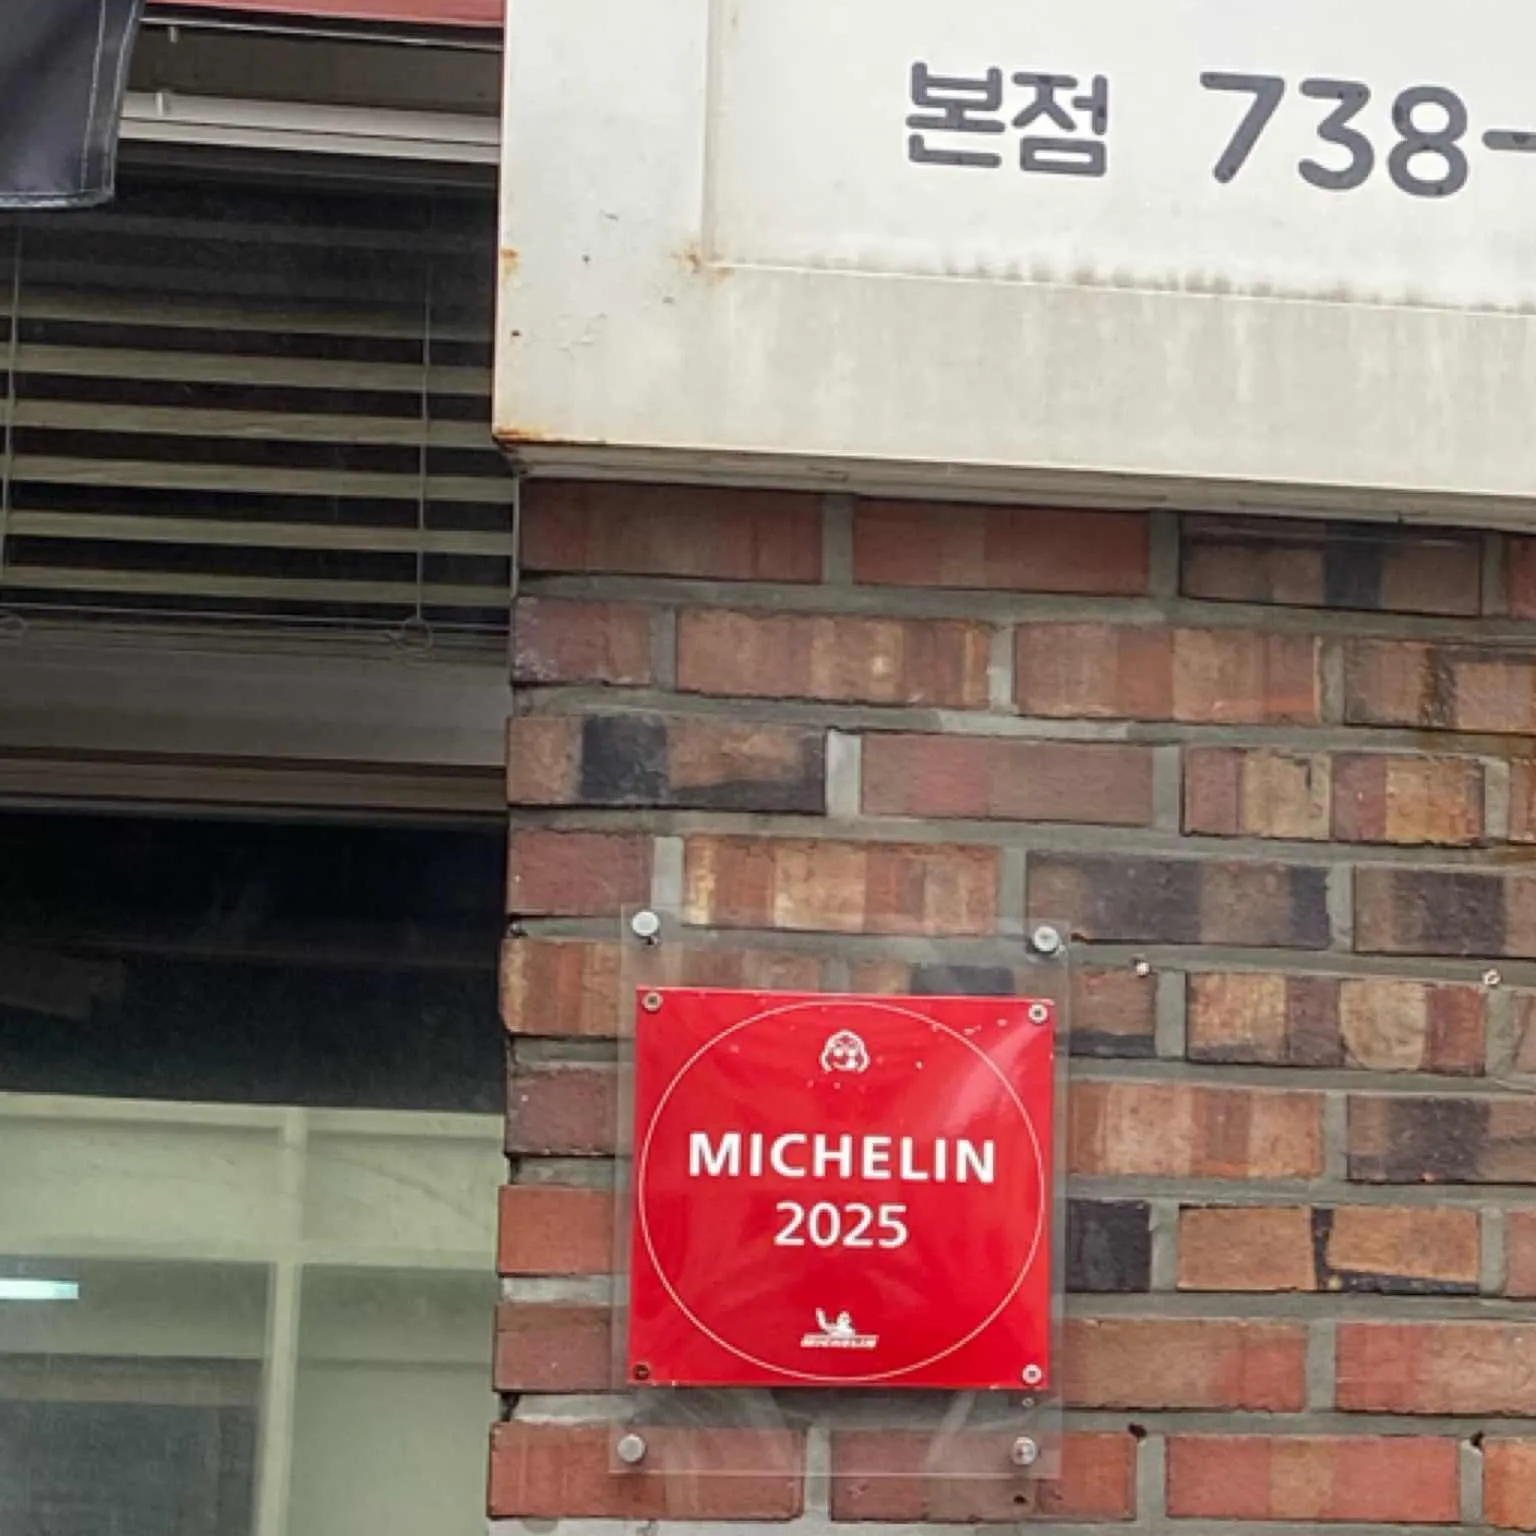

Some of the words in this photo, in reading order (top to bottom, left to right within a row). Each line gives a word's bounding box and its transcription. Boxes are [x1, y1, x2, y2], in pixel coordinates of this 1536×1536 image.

[905, 61, 1109, 178] 본점
[689, 1133, 995, 1183] MICHELIN
[774, 1201, 908, 1248] 2025
